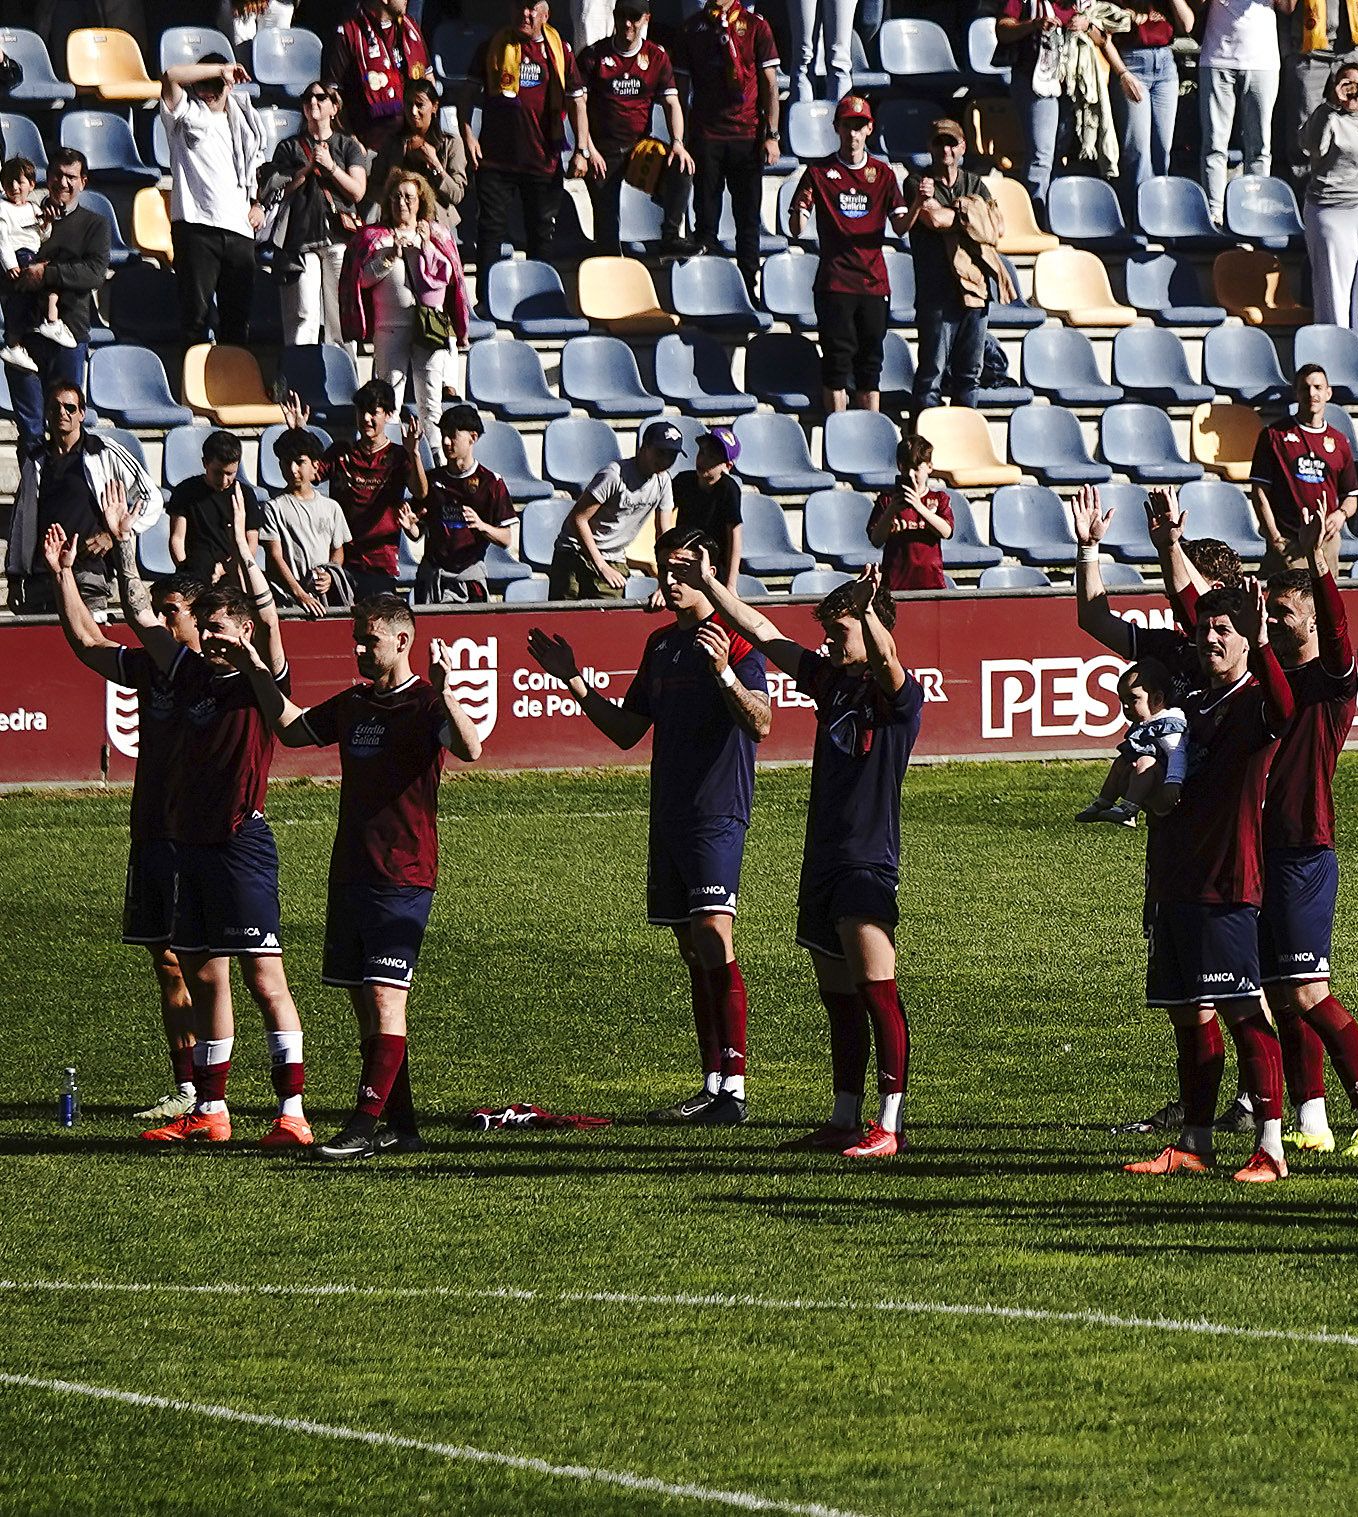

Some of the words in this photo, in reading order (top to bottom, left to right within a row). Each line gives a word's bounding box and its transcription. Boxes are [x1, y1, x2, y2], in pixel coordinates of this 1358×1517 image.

[513, 694, 543, 718] de
[355, 722, 385, 736] Estrella
[689, 885, 727, 897] ABANCA
[1196, 972, 1235, 983] ABANCA
